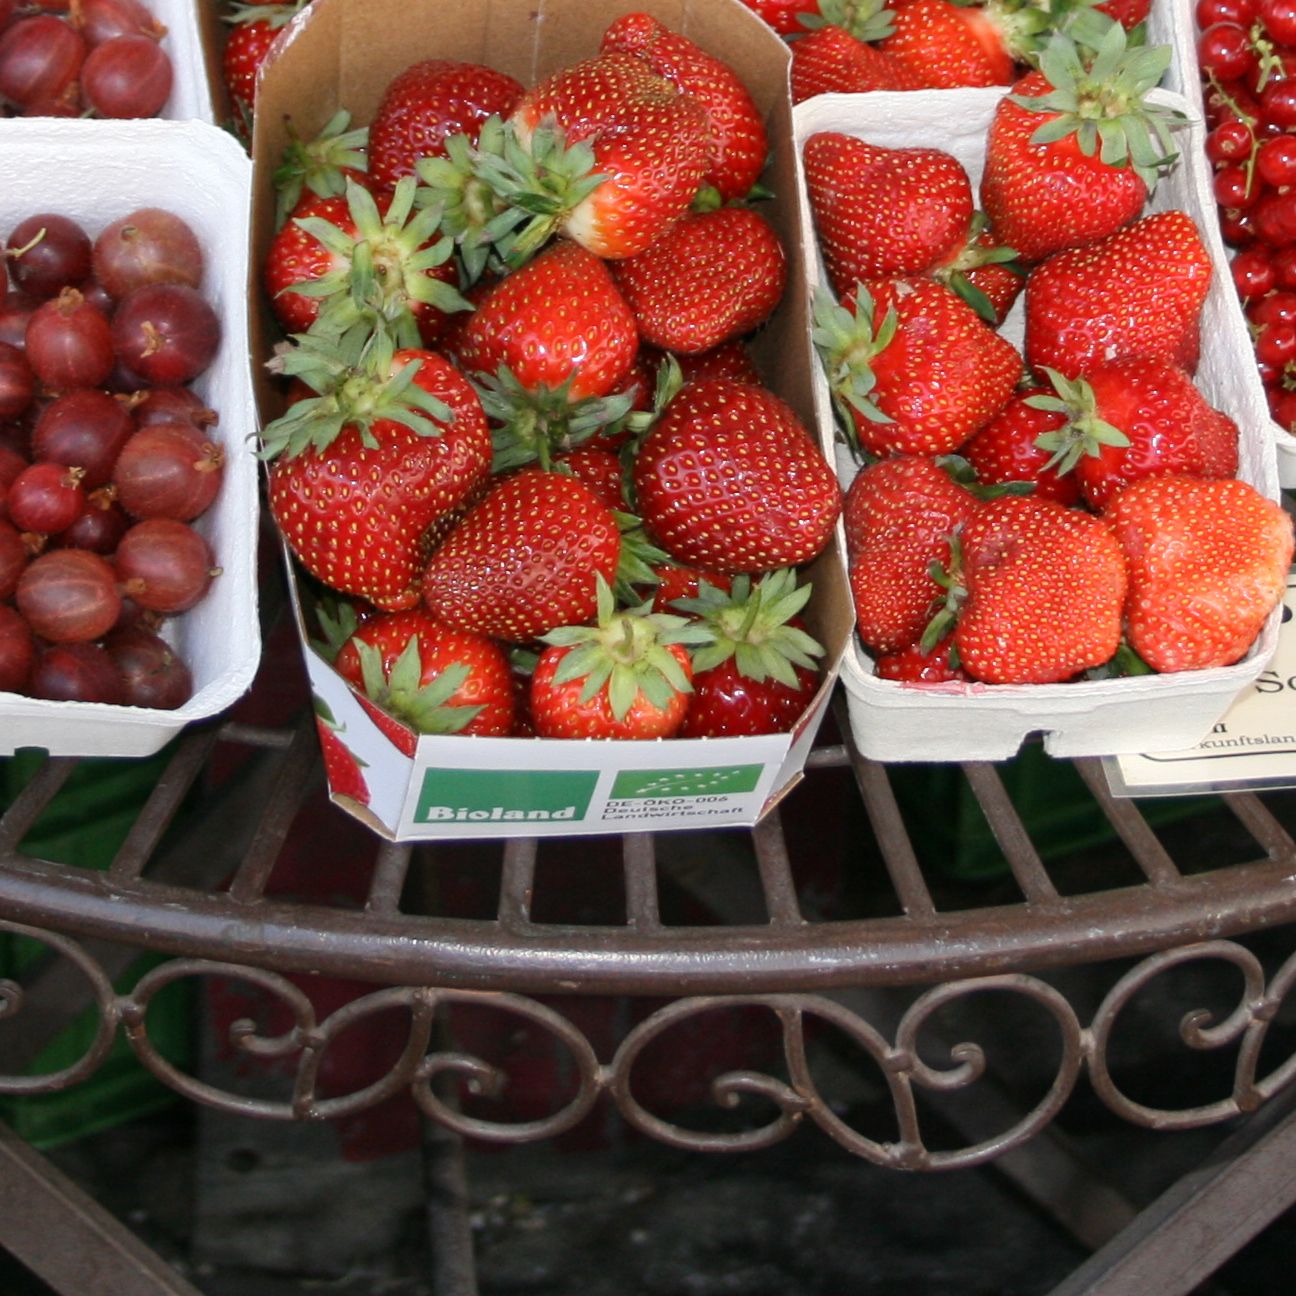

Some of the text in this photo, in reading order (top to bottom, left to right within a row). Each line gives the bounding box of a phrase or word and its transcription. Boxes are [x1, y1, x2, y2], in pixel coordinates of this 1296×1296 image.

[605, 796, 728, 807] DE-ÖKO-006
[426, 806, 576, 821] Bioland
[601, 807, 743, 821] Landwirtschaft
[604, 805, 694, 814] Deutsche
